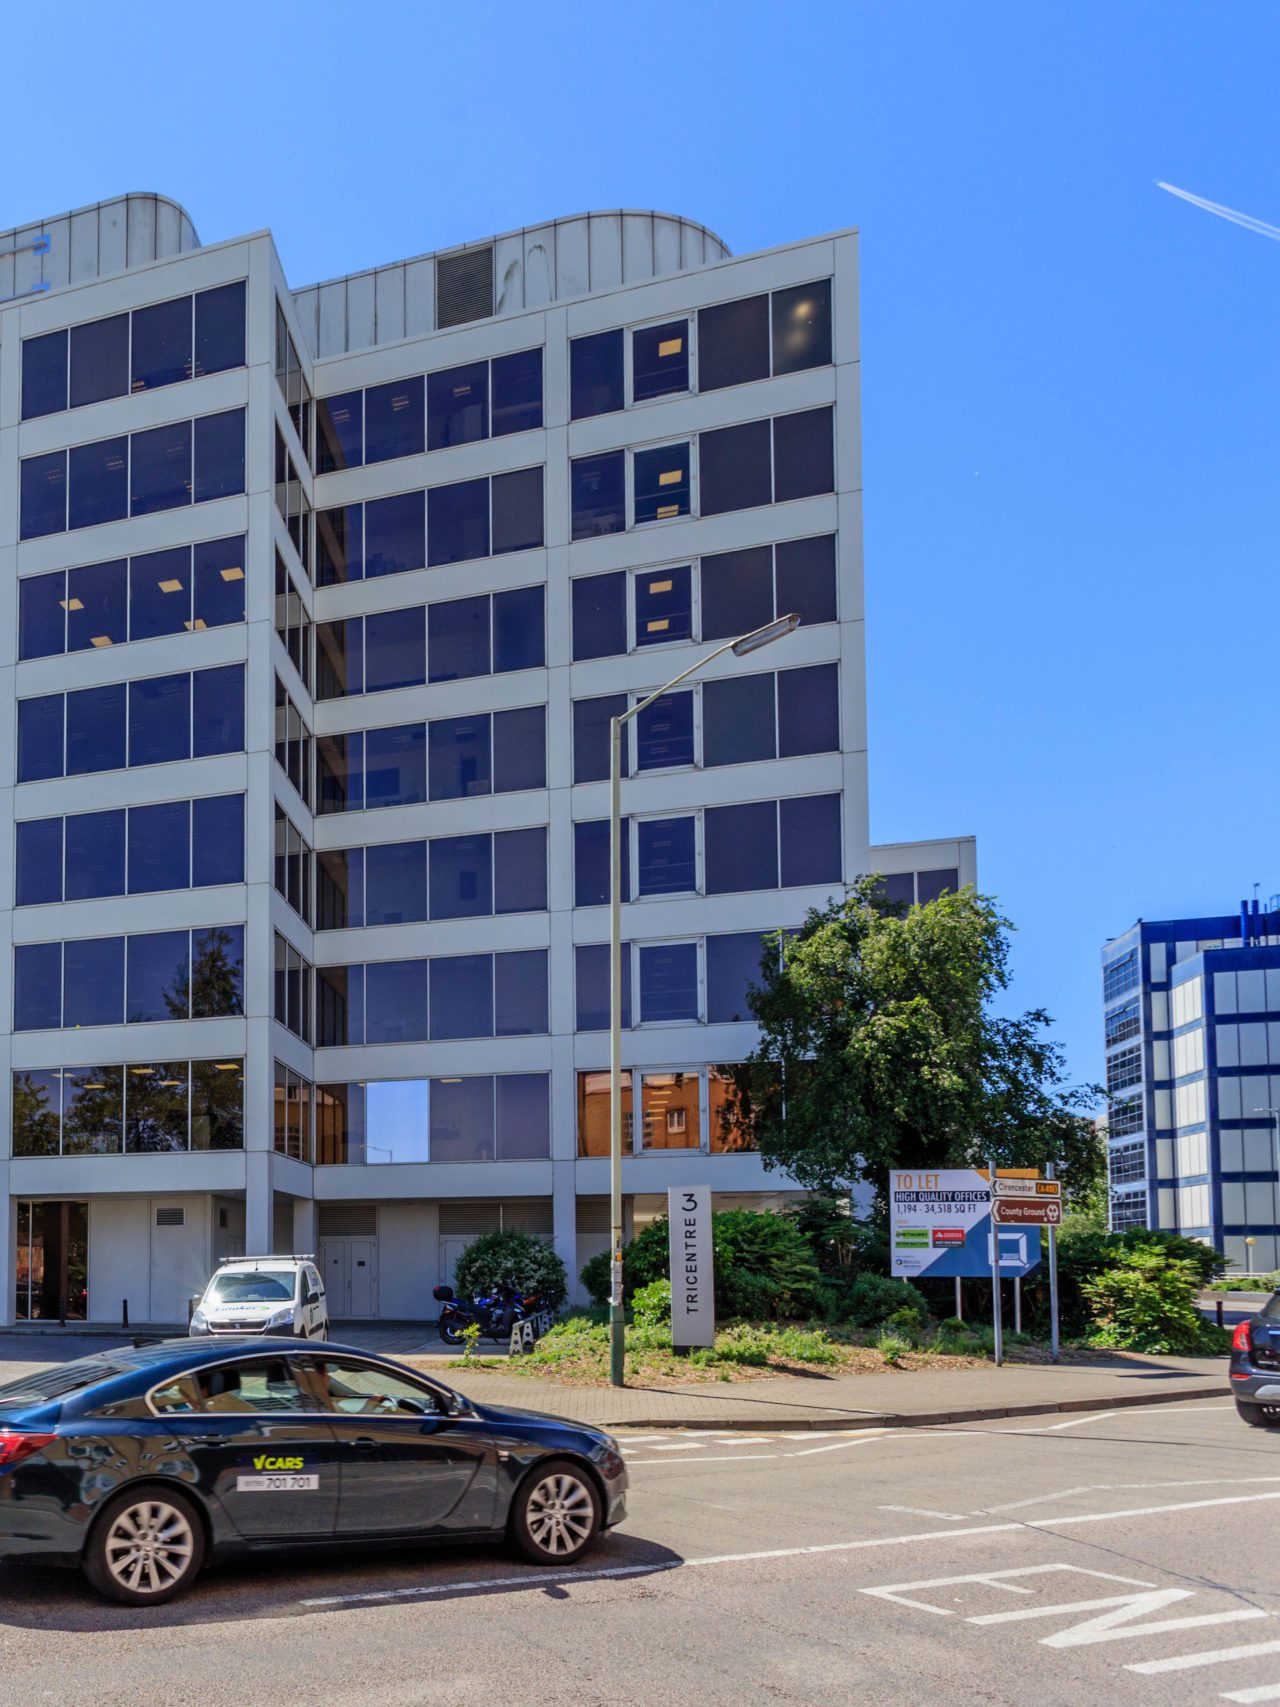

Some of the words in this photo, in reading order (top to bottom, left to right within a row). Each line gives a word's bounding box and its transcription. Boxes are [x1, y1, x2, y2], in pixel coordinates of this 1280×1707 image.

[896, 1174, 913, 1190] TO
[918, 1174, 940, 1190] LET
[681, 1193, 698, 1212] 3
[896, 1192, 916, 1201] HIGH
[919, 1192, 953, 1202] QUALITY
[955, 1192, 987, 1201] OFFICES
[897, 1204, 917, 1215] 1,194
[924, 1204, 952, 1215] 34,518
[954, 1204, 966, 1214] SQ
[968, 1204, 977, 1214] FT
[1000, 1206, 1022, 1217] County
[1023, 1207, 1046, 1216] Ground
[684, 1217, 699, 1315] TRICENTRE
[266, 1478, 287, 1488] 701
[290, 1477, 311, 1488] 701
